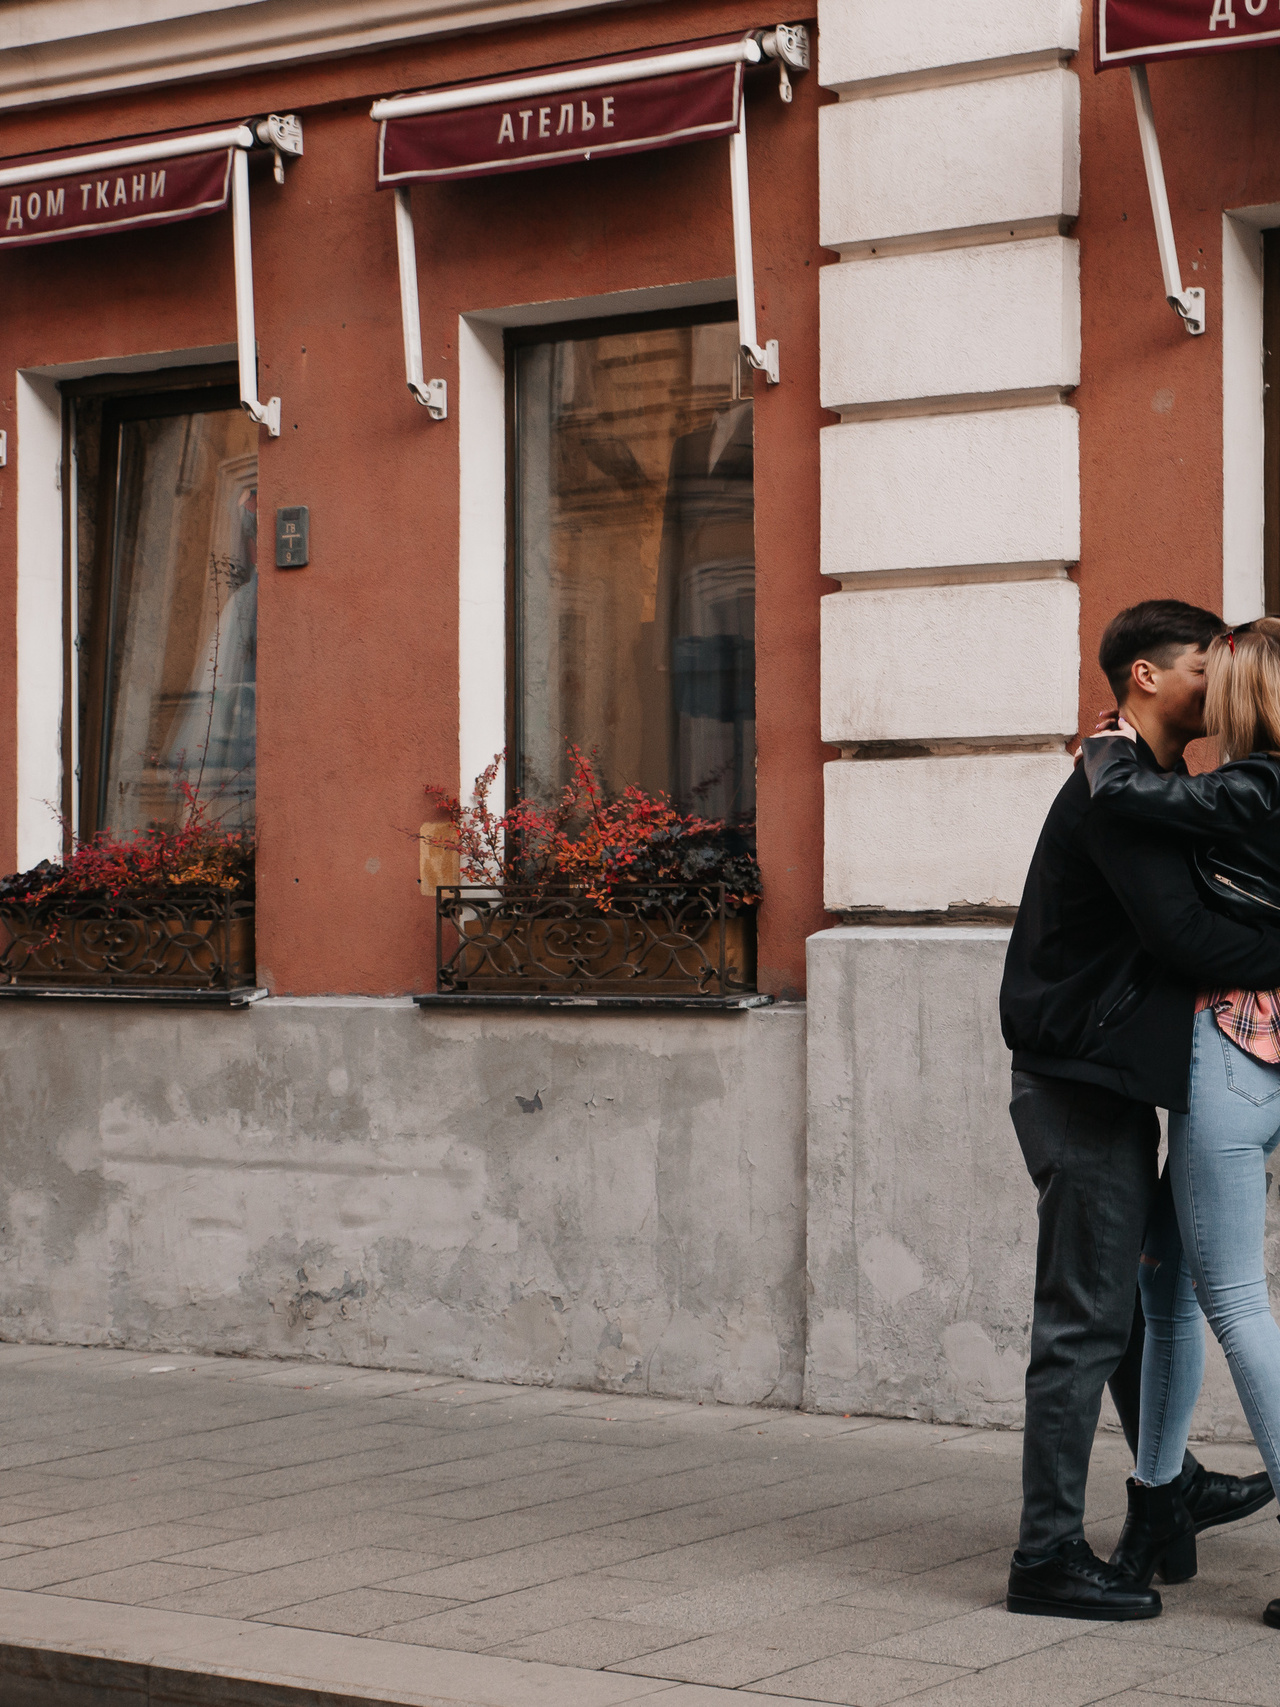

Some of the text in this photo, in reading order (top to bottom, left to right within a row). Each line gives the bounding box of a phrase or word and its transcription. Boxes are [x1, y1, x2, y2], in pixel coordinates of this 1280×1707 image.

[497, 96, 615, 144] АТЕЛЬЕ
[6, 169, 166, 230] ДОМ ТКАНИ
